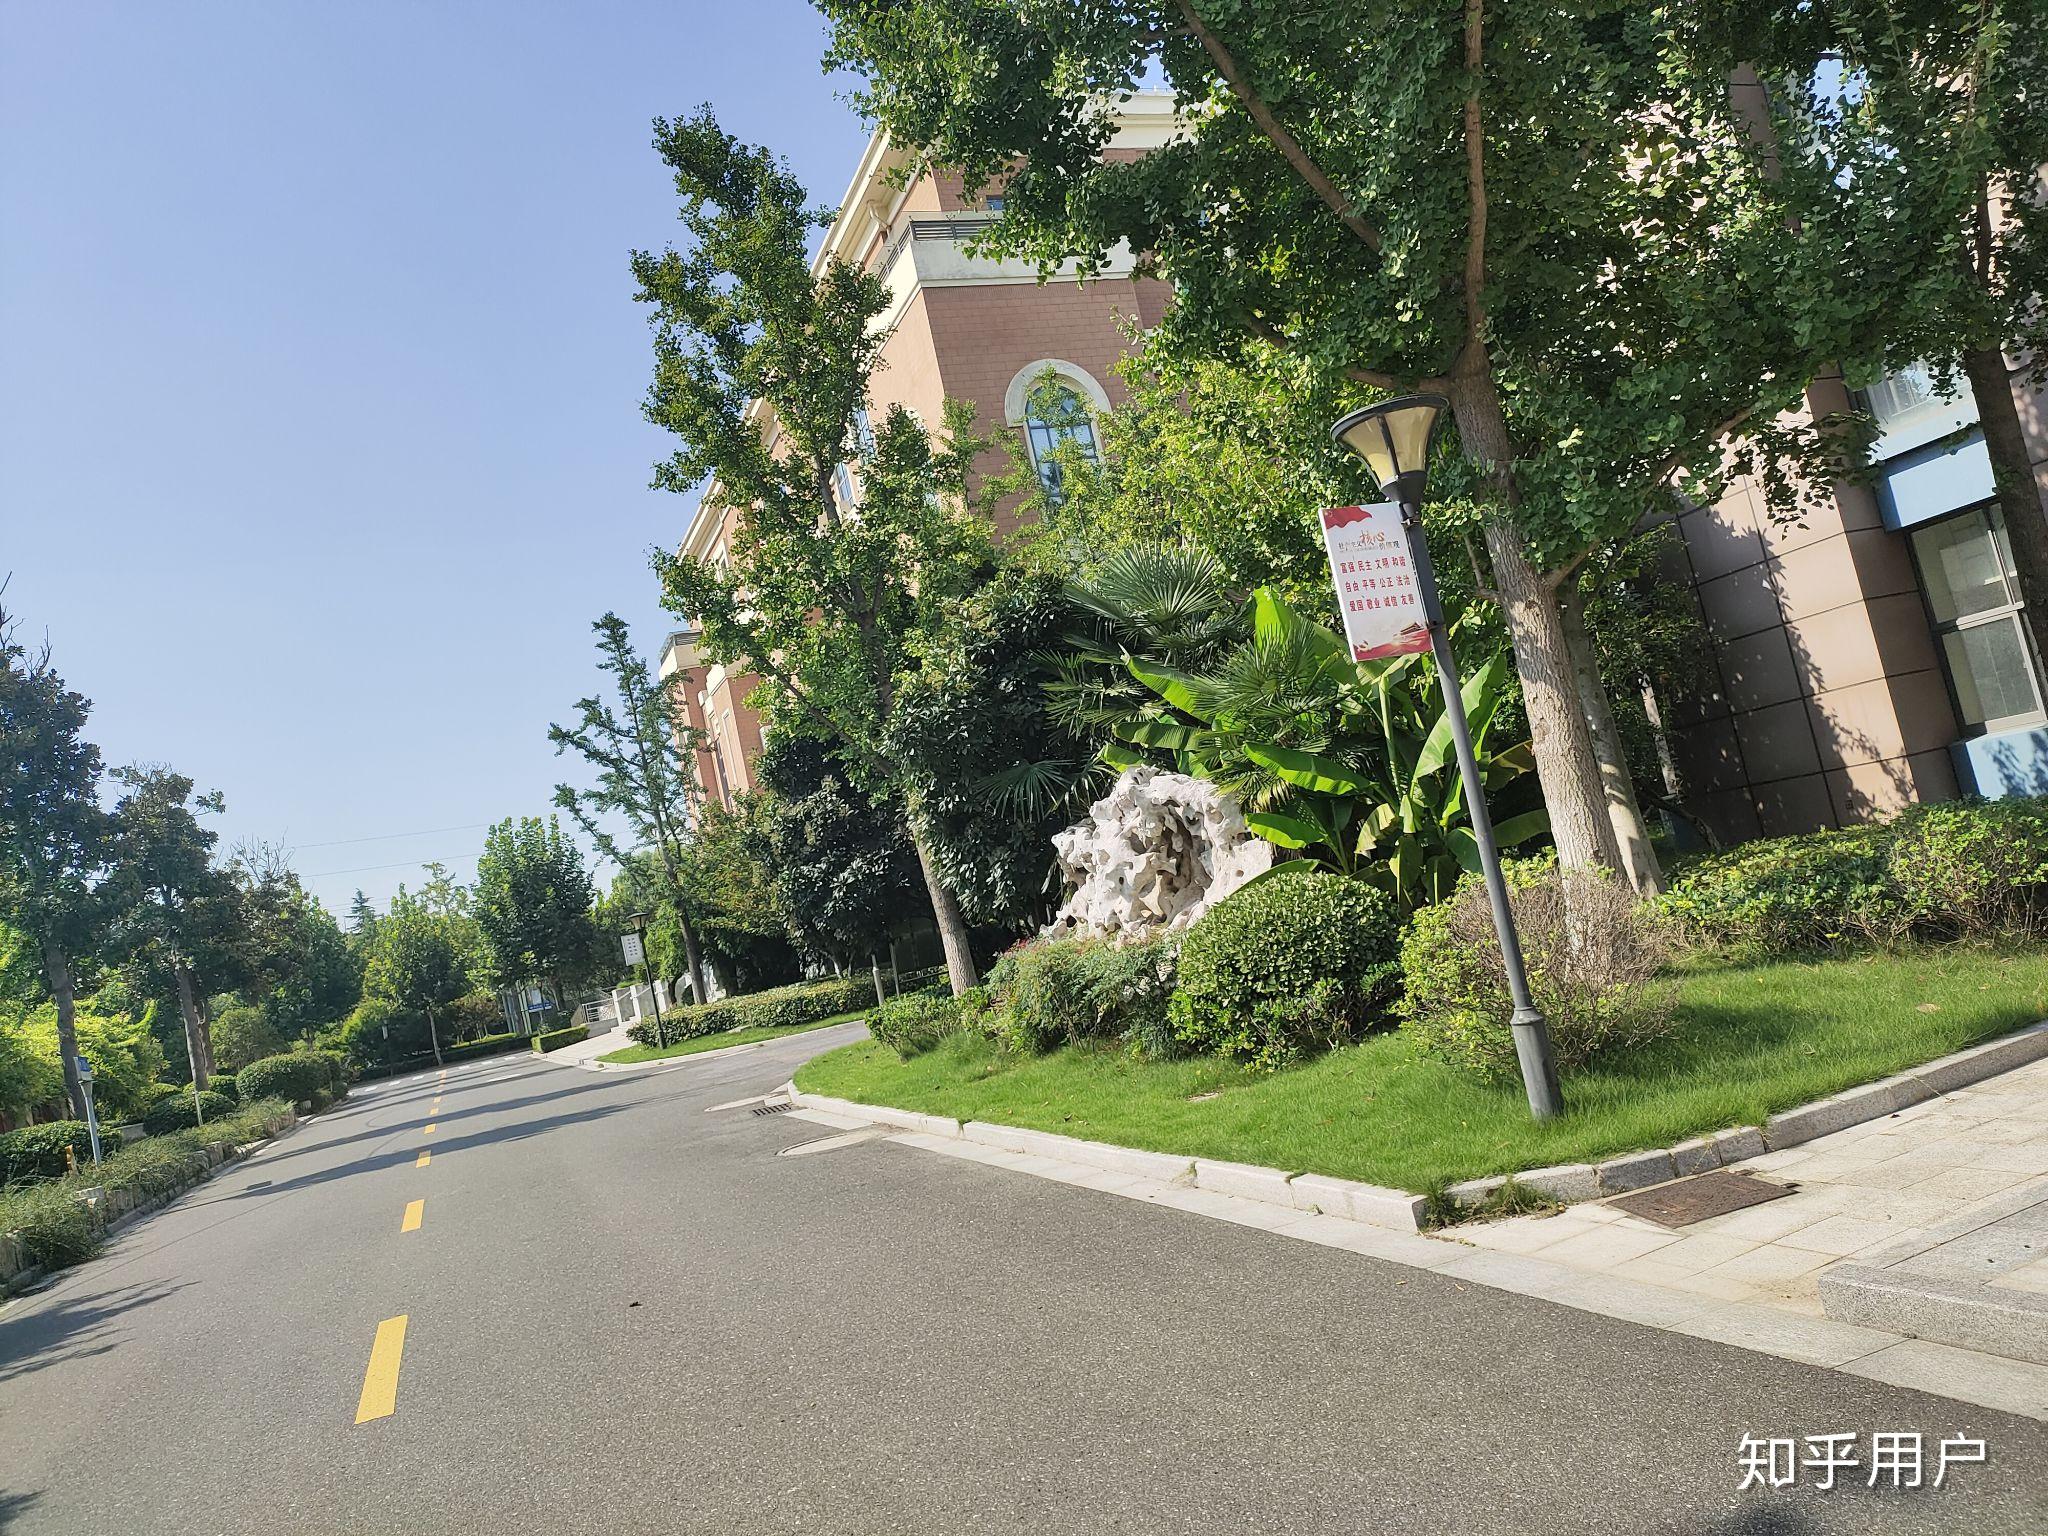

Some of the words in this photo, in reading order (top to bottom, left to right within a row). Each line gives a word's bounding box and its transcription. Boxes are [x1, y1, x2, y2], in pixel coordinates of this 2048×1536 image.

[1357, 560, 1372, 572] 民主
[1345, 581, 1360, 593] 自由
[1362, 579, 1376, 591] 平等
[1379, 577, 1394, 588] 公正
